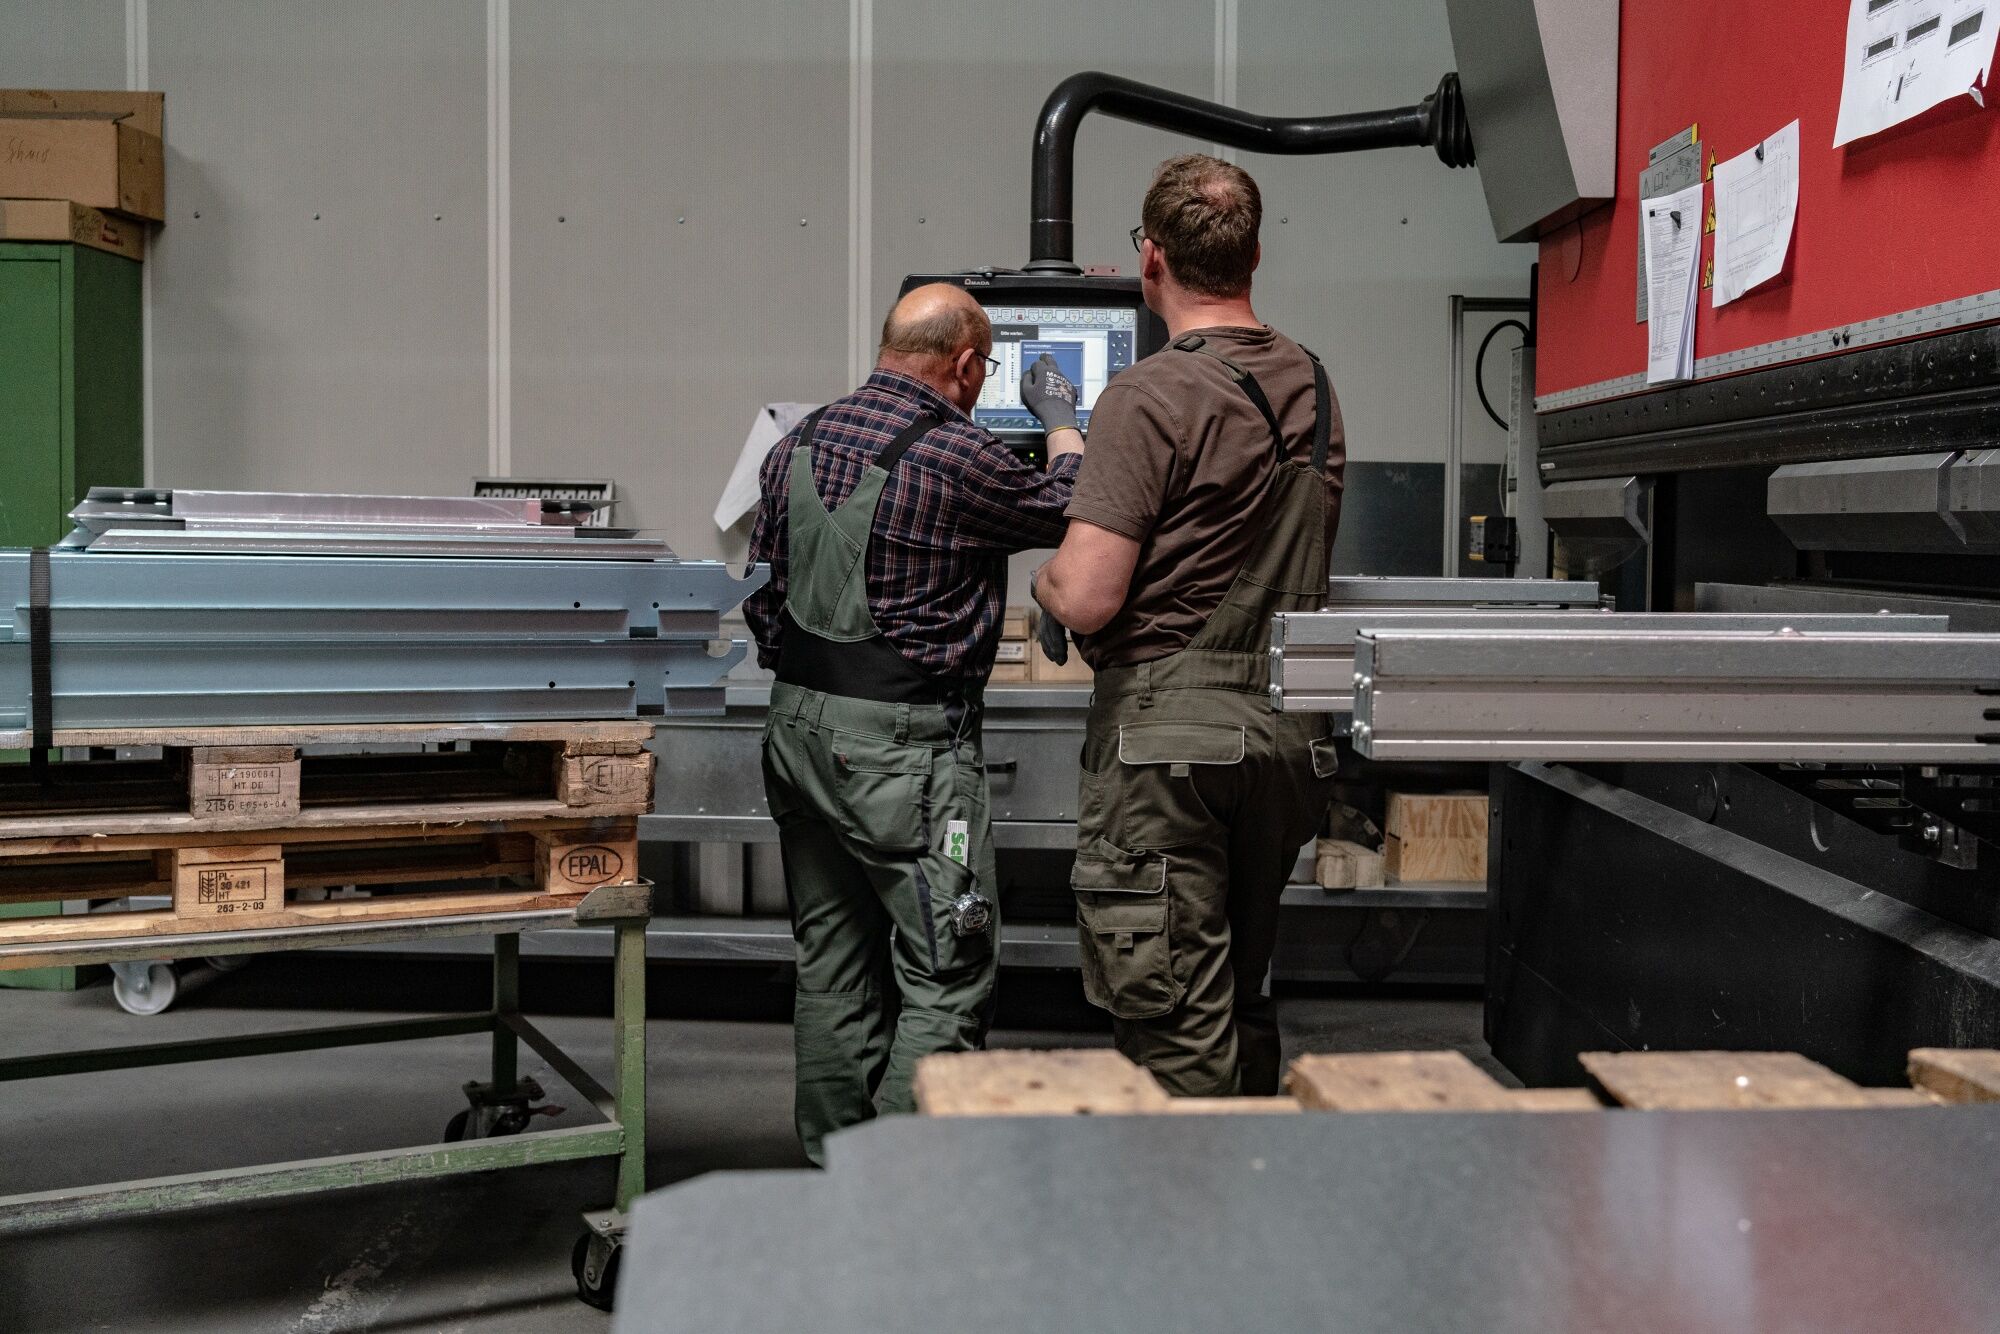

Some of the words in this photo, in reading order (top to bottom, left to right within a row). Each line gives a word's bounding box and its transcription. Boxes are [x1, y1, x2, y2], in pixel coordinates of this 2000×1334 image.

[234, 781, 246, 790] HT
[205, 799, 235, 812] 2156
[568, 854, 613, 877] EPAL
[218, 872, 234, 881] PL-
[218, 891, 231, 900] HT
[217, 902, 264, 913] 263-2-03
